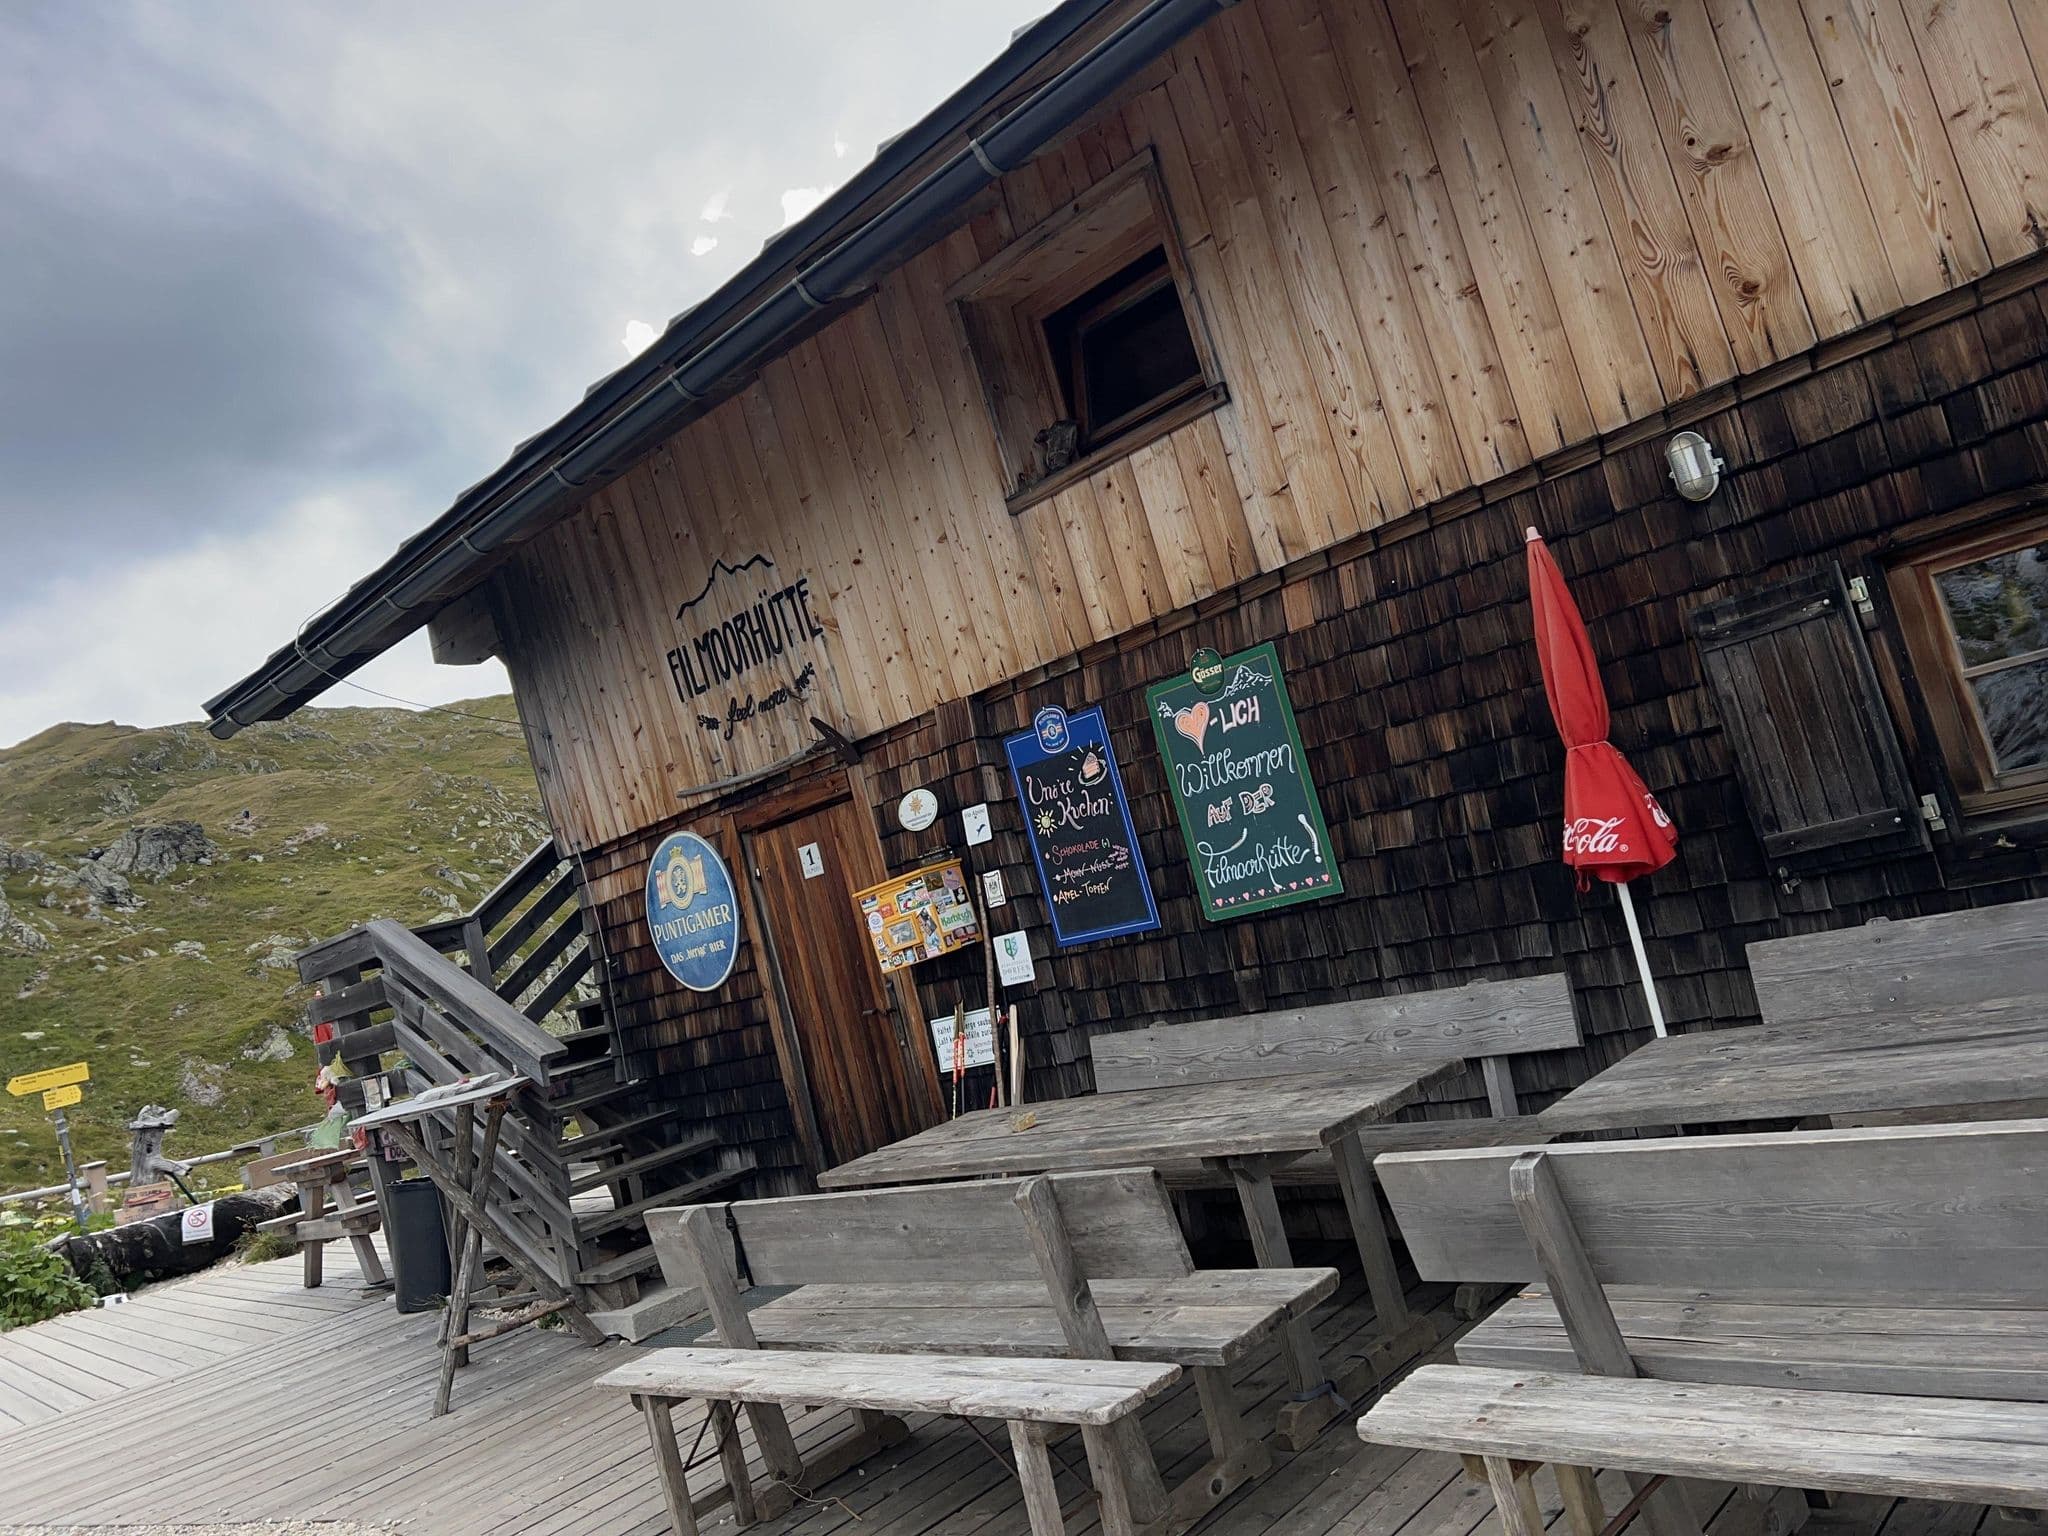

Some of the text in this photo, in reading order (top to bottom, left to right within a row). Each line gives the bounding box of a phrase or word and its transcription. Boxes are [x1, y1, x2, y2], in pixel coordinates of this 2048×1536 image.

[666, 578, 823, 703] FILMOORHÜTTE
[1192, 664, 1222, 683] Gösser
[724, 687, 789, 741] feel more
[1176, 743, 1296, 797] Willkommen
[1058, 790, 1114, 830] Kuchen:
[1207, 783, 1276, 827] AUF DER
[806, 848, 815, 866] 1
[1051, 839, 1100, 865] SCHOKOLADE
[654, 903, 732, 945] PUNTIGAMER
[670, 951, 685, 964] DAS
[708, 939, 727, 953] BIER
